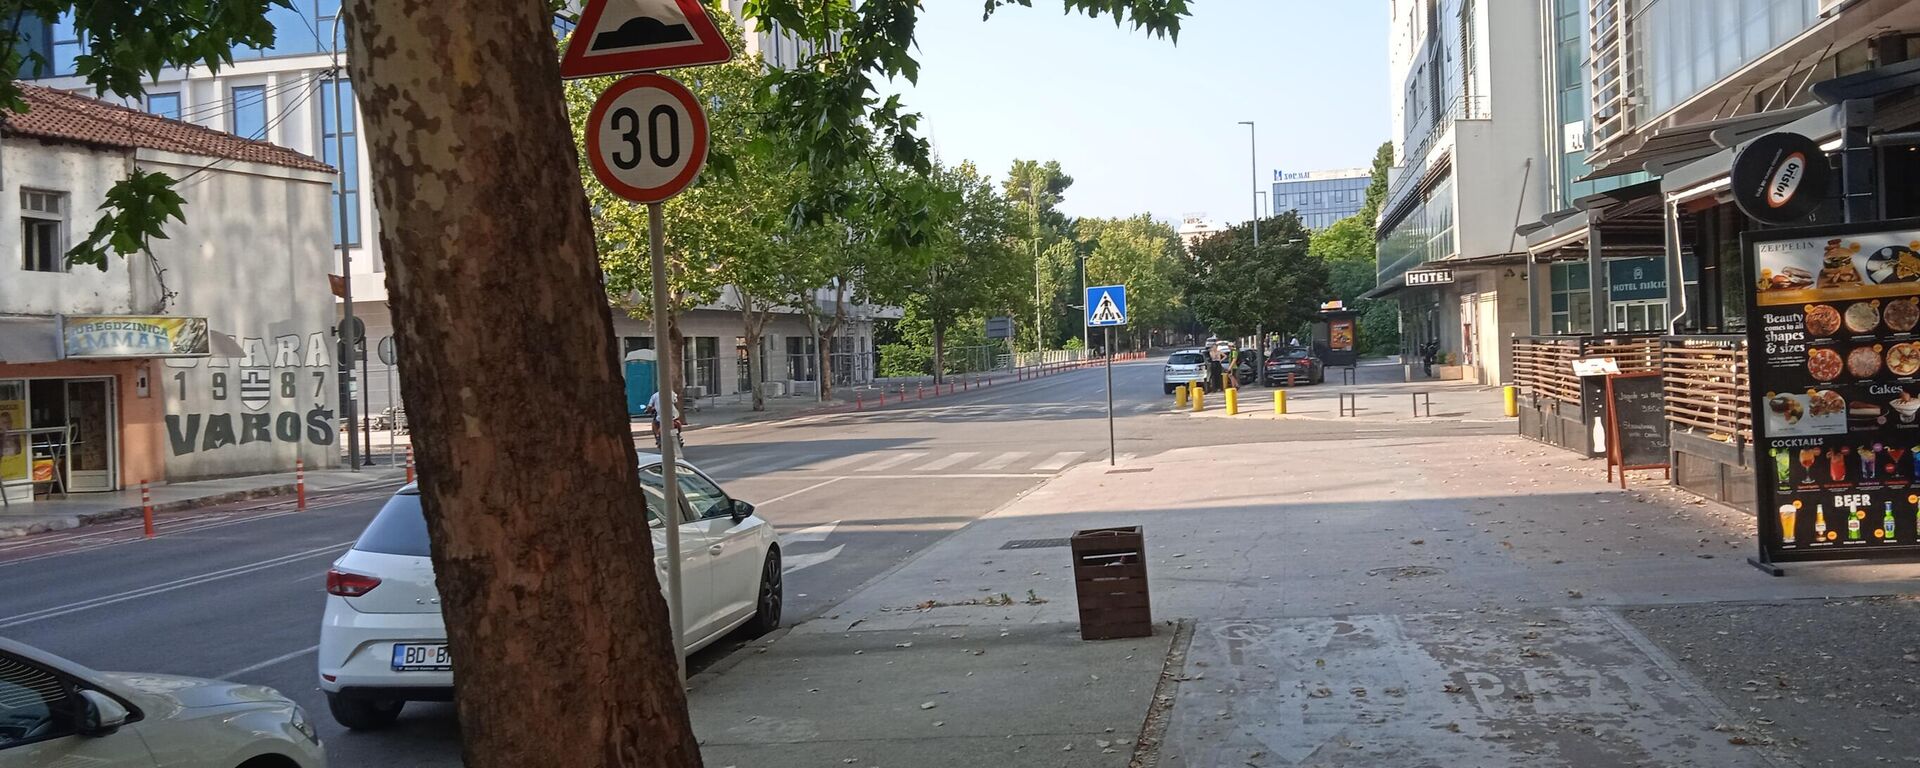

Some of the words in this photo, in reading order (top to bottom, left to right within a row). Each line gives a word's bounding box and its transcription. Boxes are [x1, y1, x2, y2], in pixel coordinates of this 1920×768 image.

[611, 104, 680, 170] 30
[1774, 163, 1799, 198] bristot
[1760, 241, 1815, 253] ZEPPELIN
[1409, 271, 1452, 284] HOTEL
[1613, 283, 1638, 292] HOTEL
[1763, 313, 1804, 324] Beauty
[1765, 331, 1805, 343] shapes
[165, 332, 331, 368] ARA
[1766, 343, 1777, 355] &
[1779, 343, 1806, 353] sizes
[1869, 384, 1903, 395] Cakes
[165, 403, 334, 457] VAROŠ
[1771, 438, 1824, 448] COCKTAILS
[1834, 494, 1872, 507] BEER
[405, 647, 426, 664] BD
